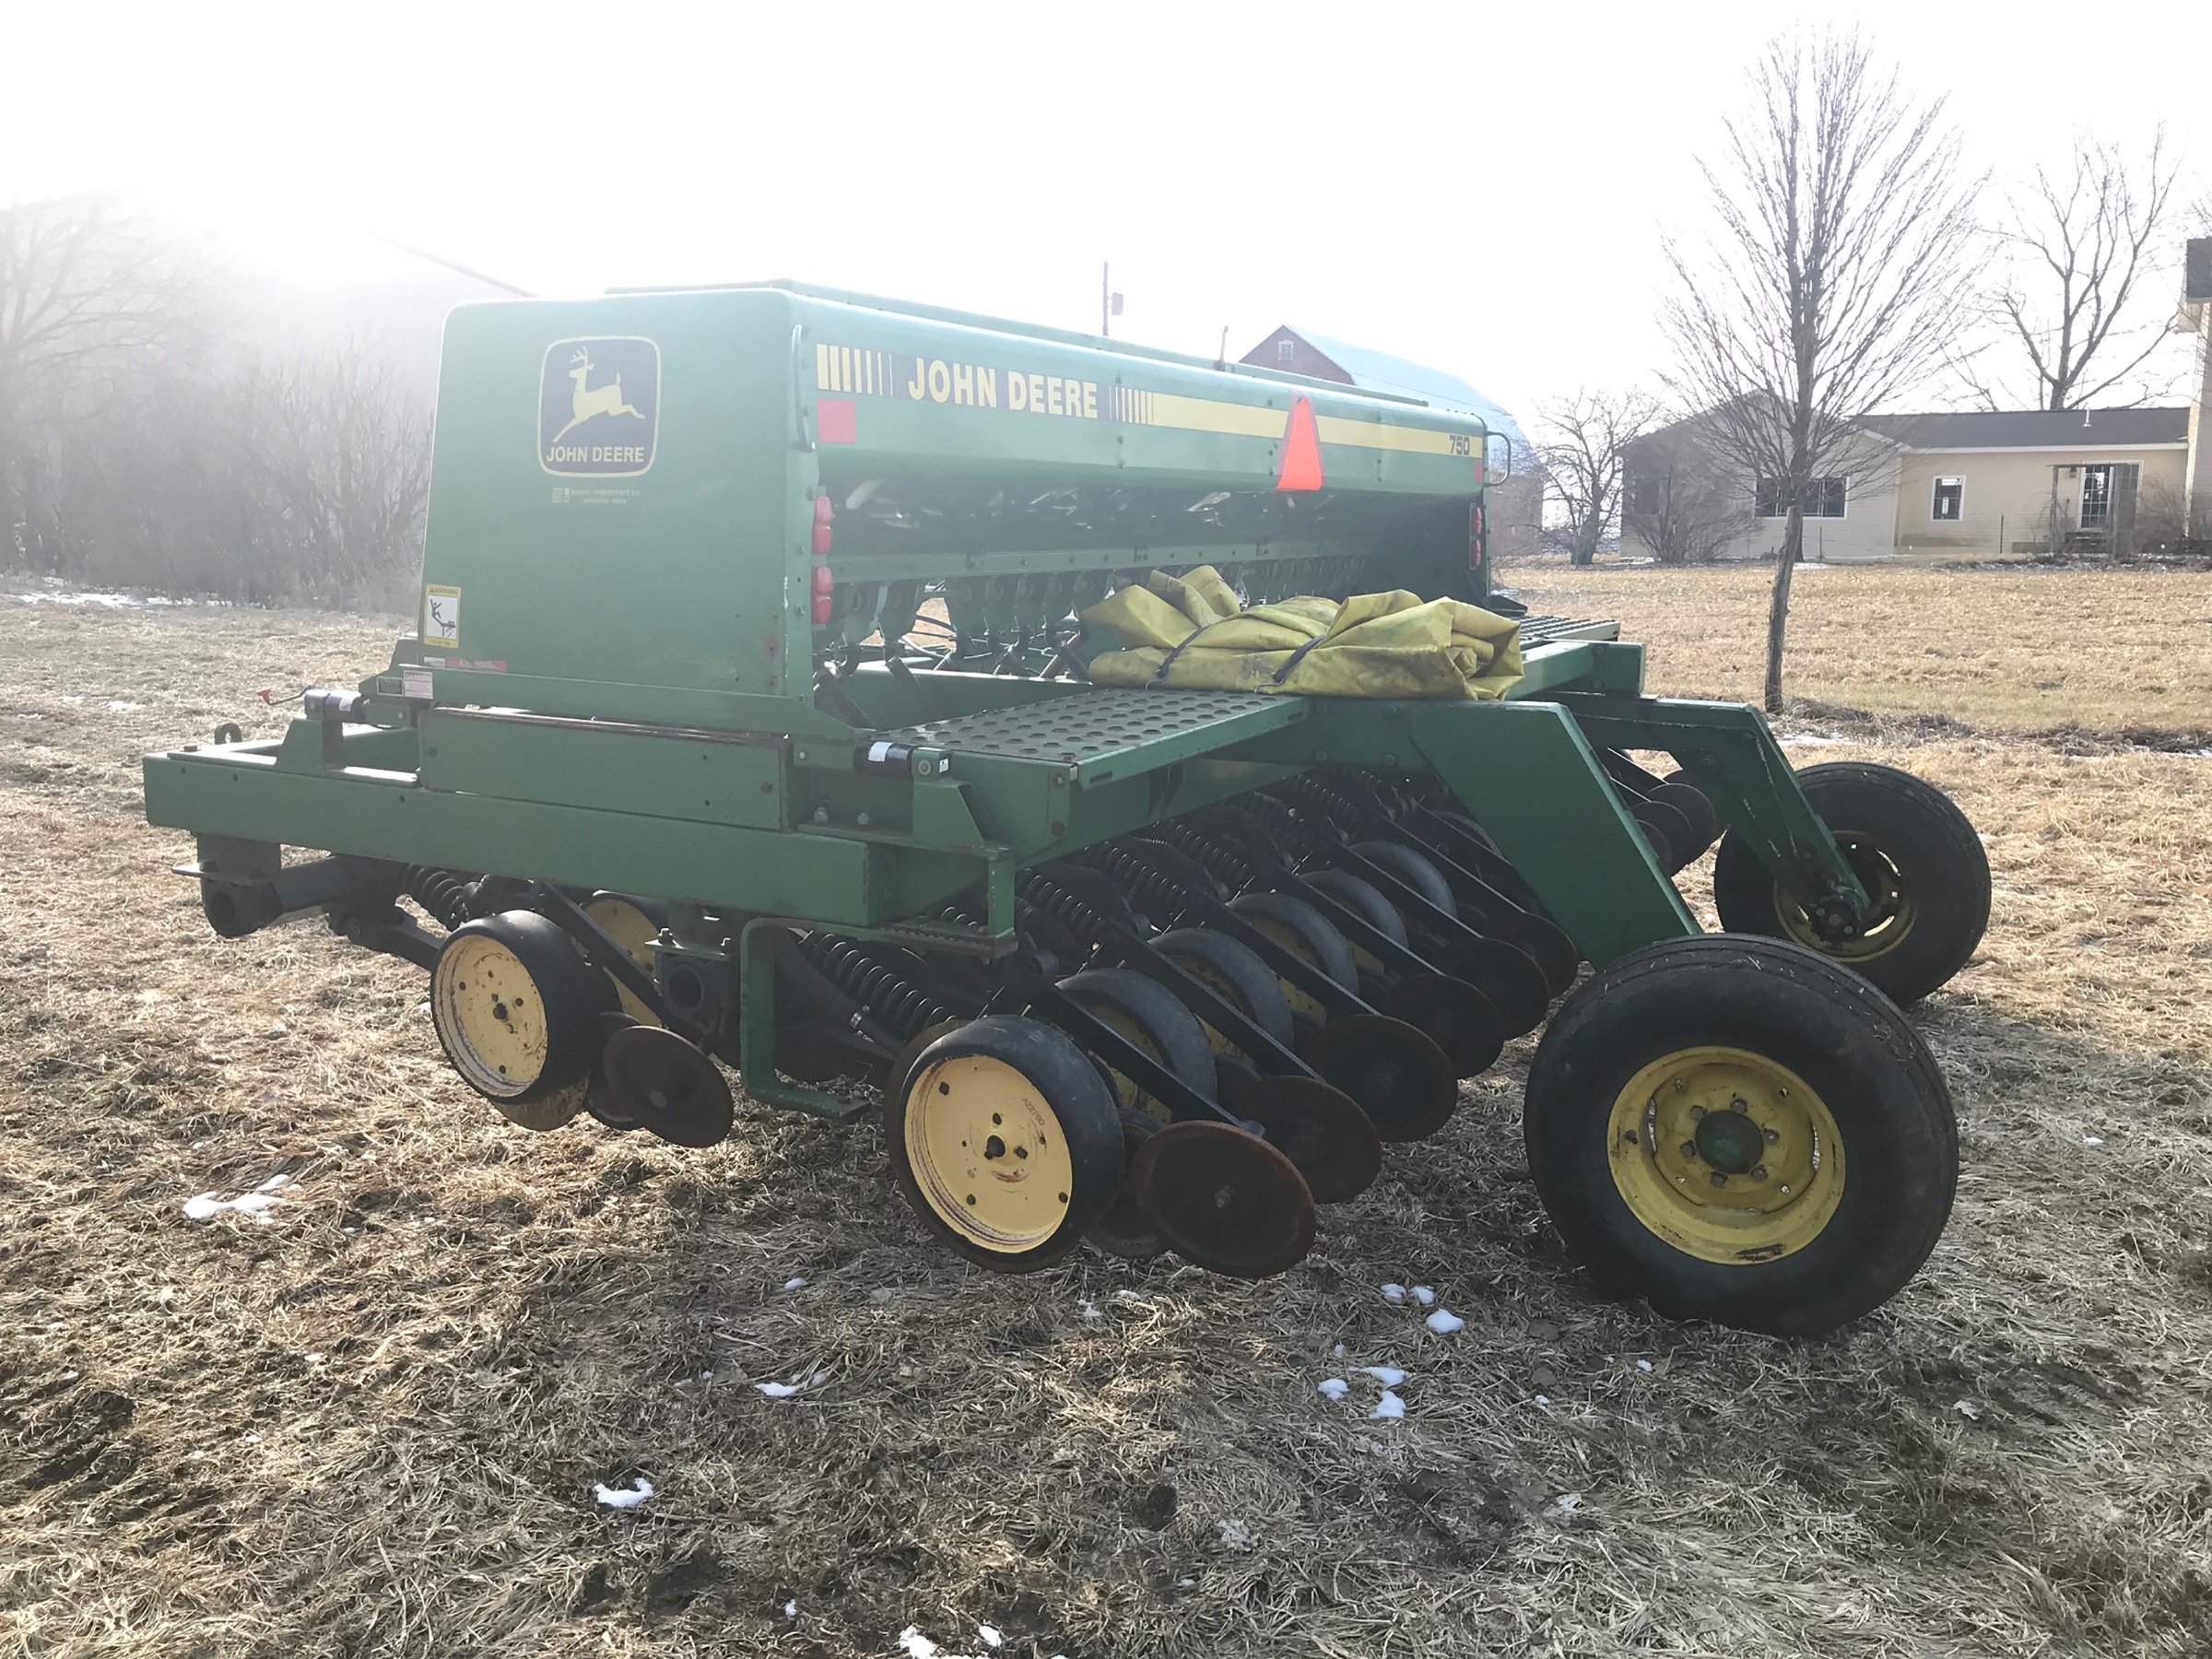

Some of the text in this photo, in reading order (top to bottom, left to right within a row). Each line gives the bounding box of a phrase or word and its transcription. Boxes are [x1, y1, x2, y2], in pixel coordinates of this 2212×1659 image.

[908, 357, 1098, 418] JOHN DEERE
[546, 446, 645, 463] JOHN DEERE
[1449, 434, 1470, 456] 750
